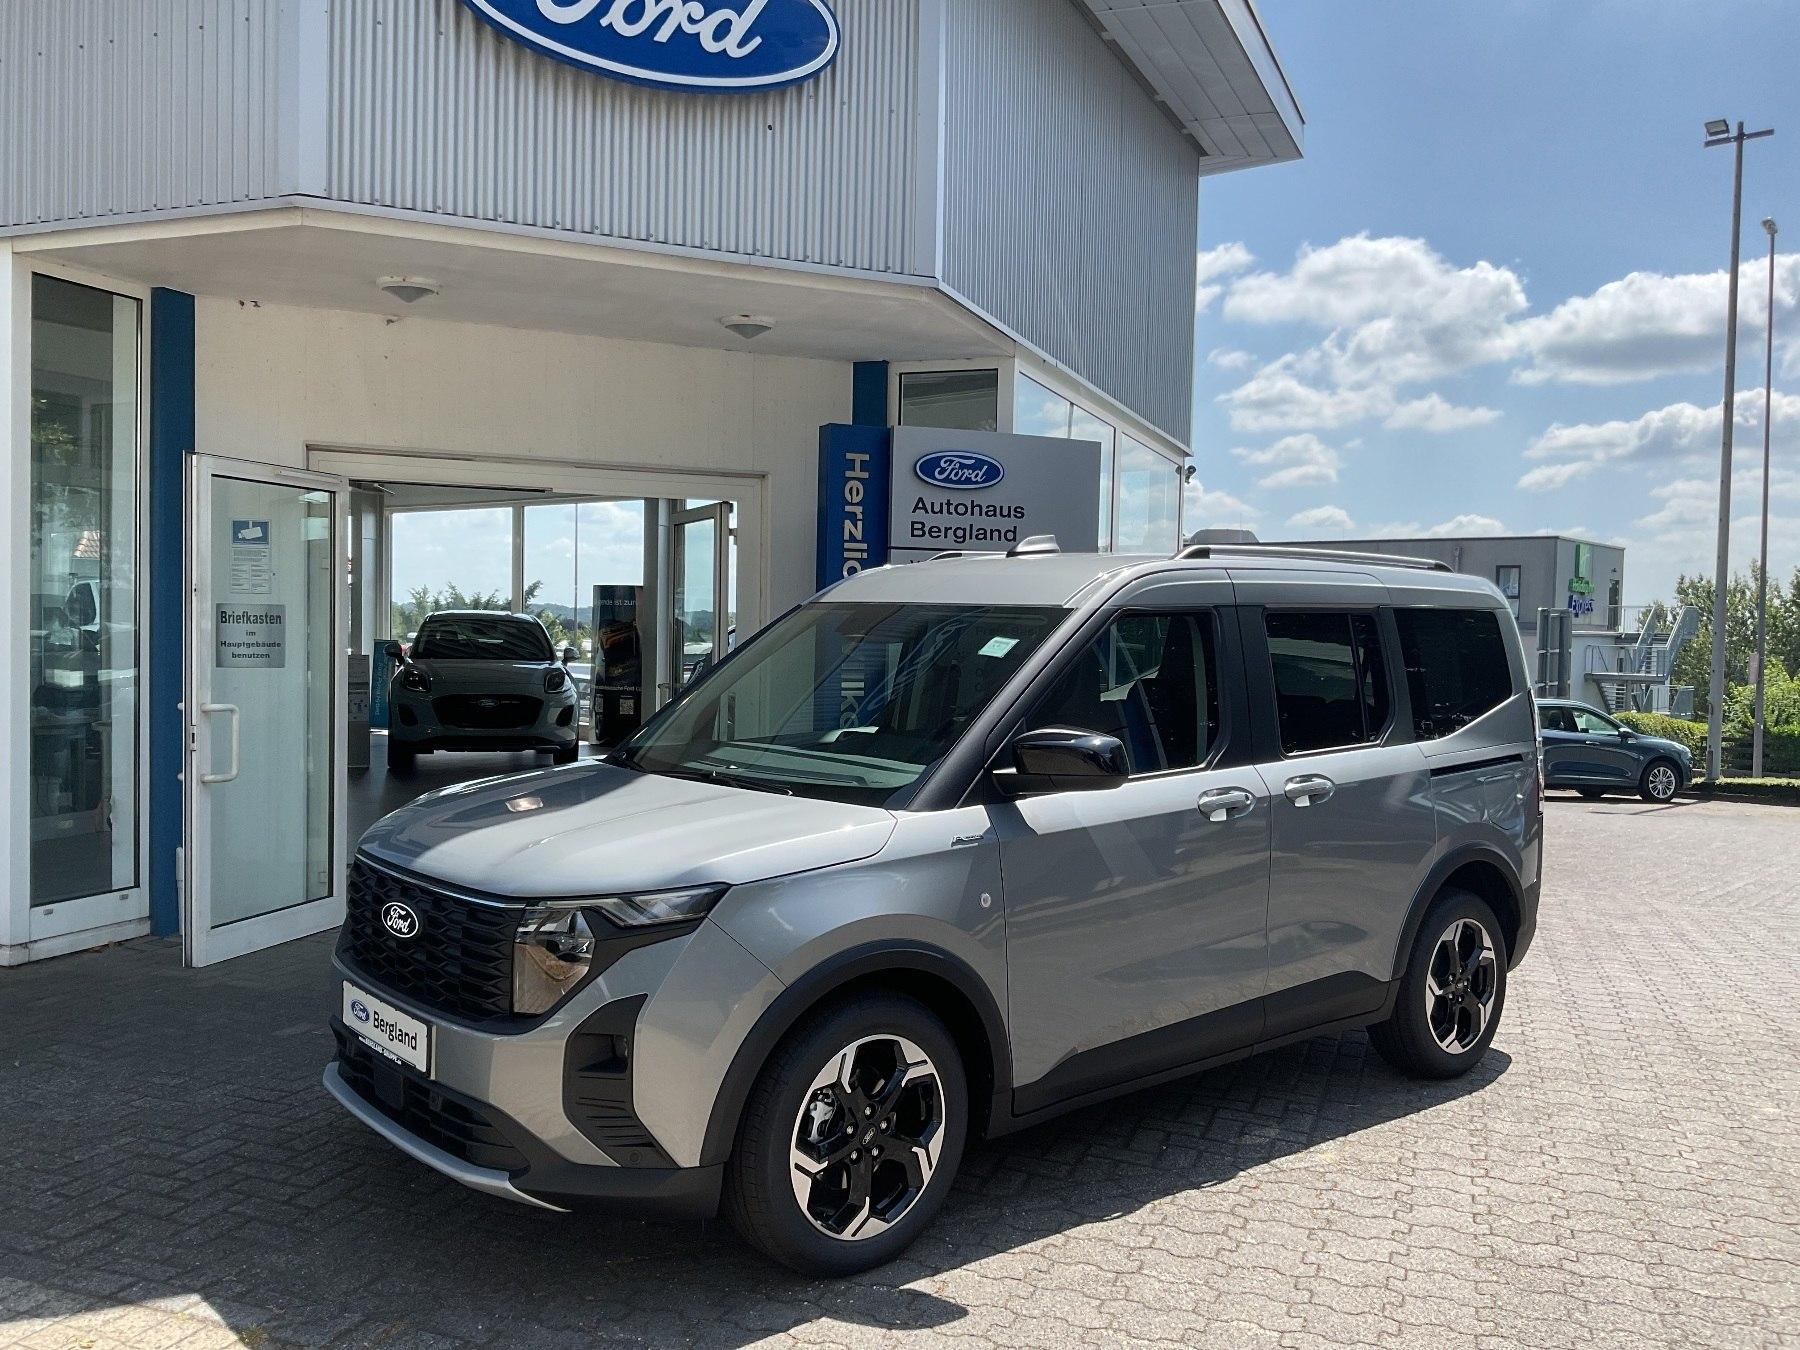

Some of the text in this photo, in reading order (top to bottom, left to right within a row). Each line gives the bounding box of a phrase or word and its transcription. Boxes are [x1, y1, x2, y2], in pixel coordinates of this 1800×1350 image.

[934, 456, 988, 482] Ford
[911, 496, 1025, 520] Autohaus
[910, 520, 1018, 544] Bergland
[220, 611, 282, 625] Briefkasten
[387, 905, 411, 933] Ford
[353, 1004, 368, 1021] Ford
[373, 1010, 418, 1051] Bergland
